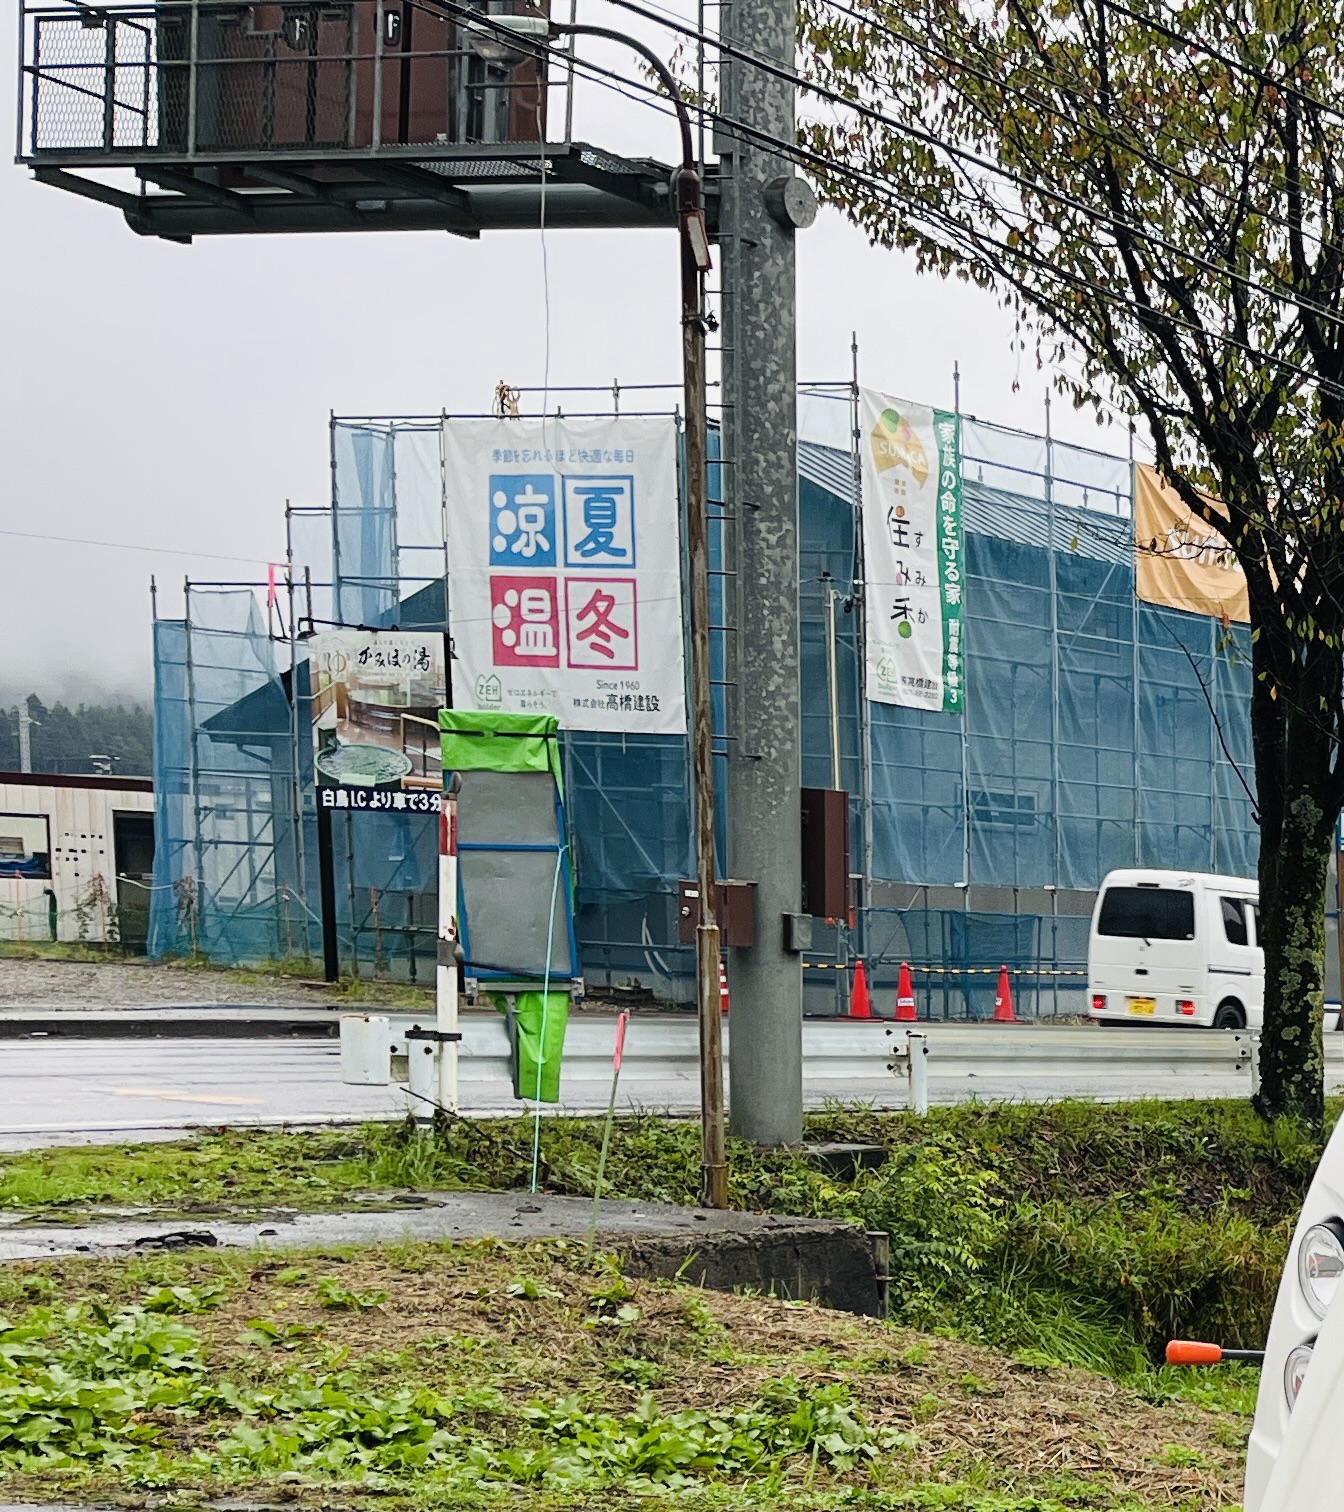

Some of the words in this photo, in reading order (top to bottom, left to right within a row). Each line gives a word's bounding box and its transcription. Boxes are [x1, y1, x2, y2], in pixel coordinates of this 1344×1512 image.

[491, 449, 634, 463] 季節を忘れるほど快適な毎日
[492, 483, 550, 558] 涼
[573, 486, 628, 558] 夏
[938, 421, 961, 605] 家族の命を守る家
[492, 588, 558, 657] 温
[575, 588, 630, 660] 冬
[479, 684, 499, 696] ZEH
[596, 680, 618, 691] Since
[620, 681, 640, 691] 1960
